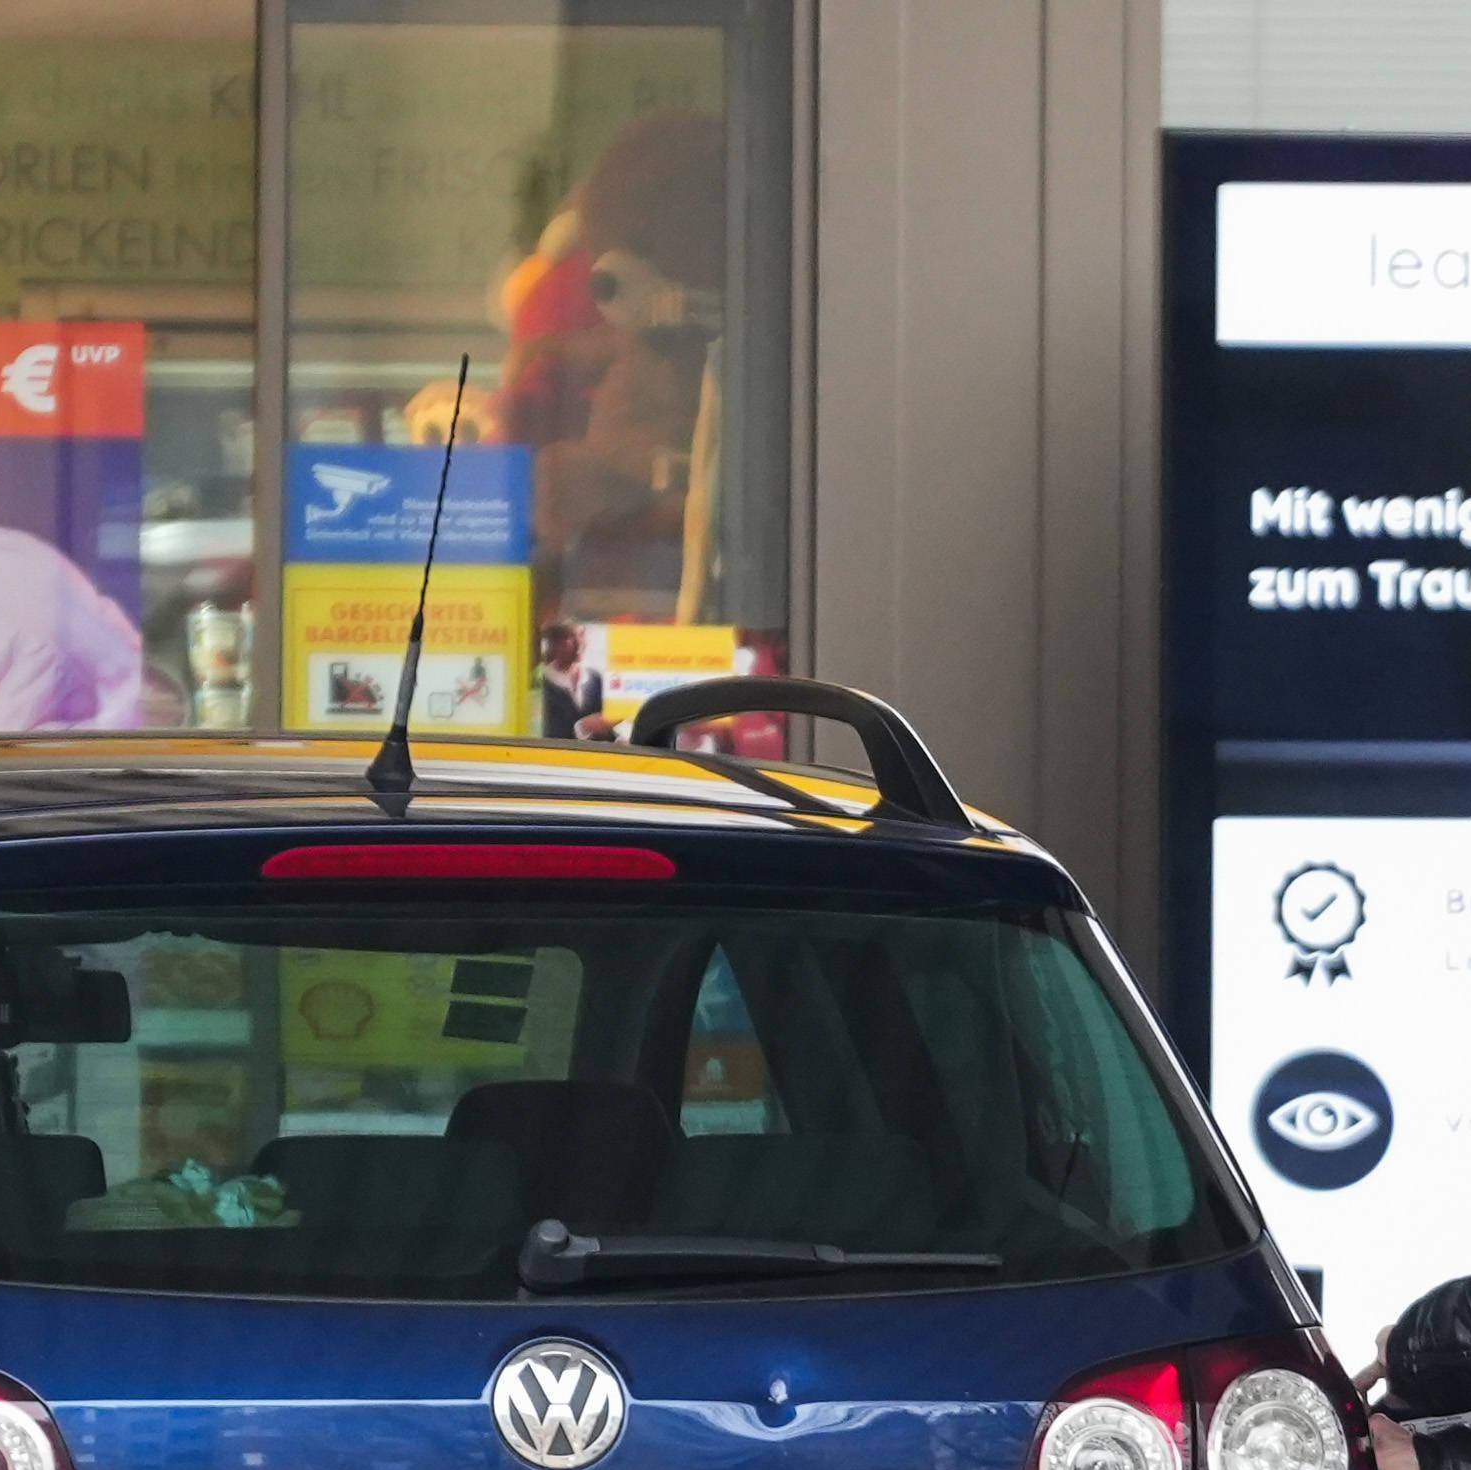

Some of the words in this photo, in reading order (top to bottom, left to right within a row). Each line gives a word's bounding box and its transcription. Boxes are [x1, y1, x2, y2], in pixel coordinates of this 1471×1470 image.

[0, 343, 60, 413] €
[71, 345, 121, 364] UVP
[1250, 489, 1332, 538] Mit
[1248, 566, 1359, 609] zum
[329, 602, 484, 622] GESICHRTES
[304, 625, 509, 645] BARGELDYSTEM!
